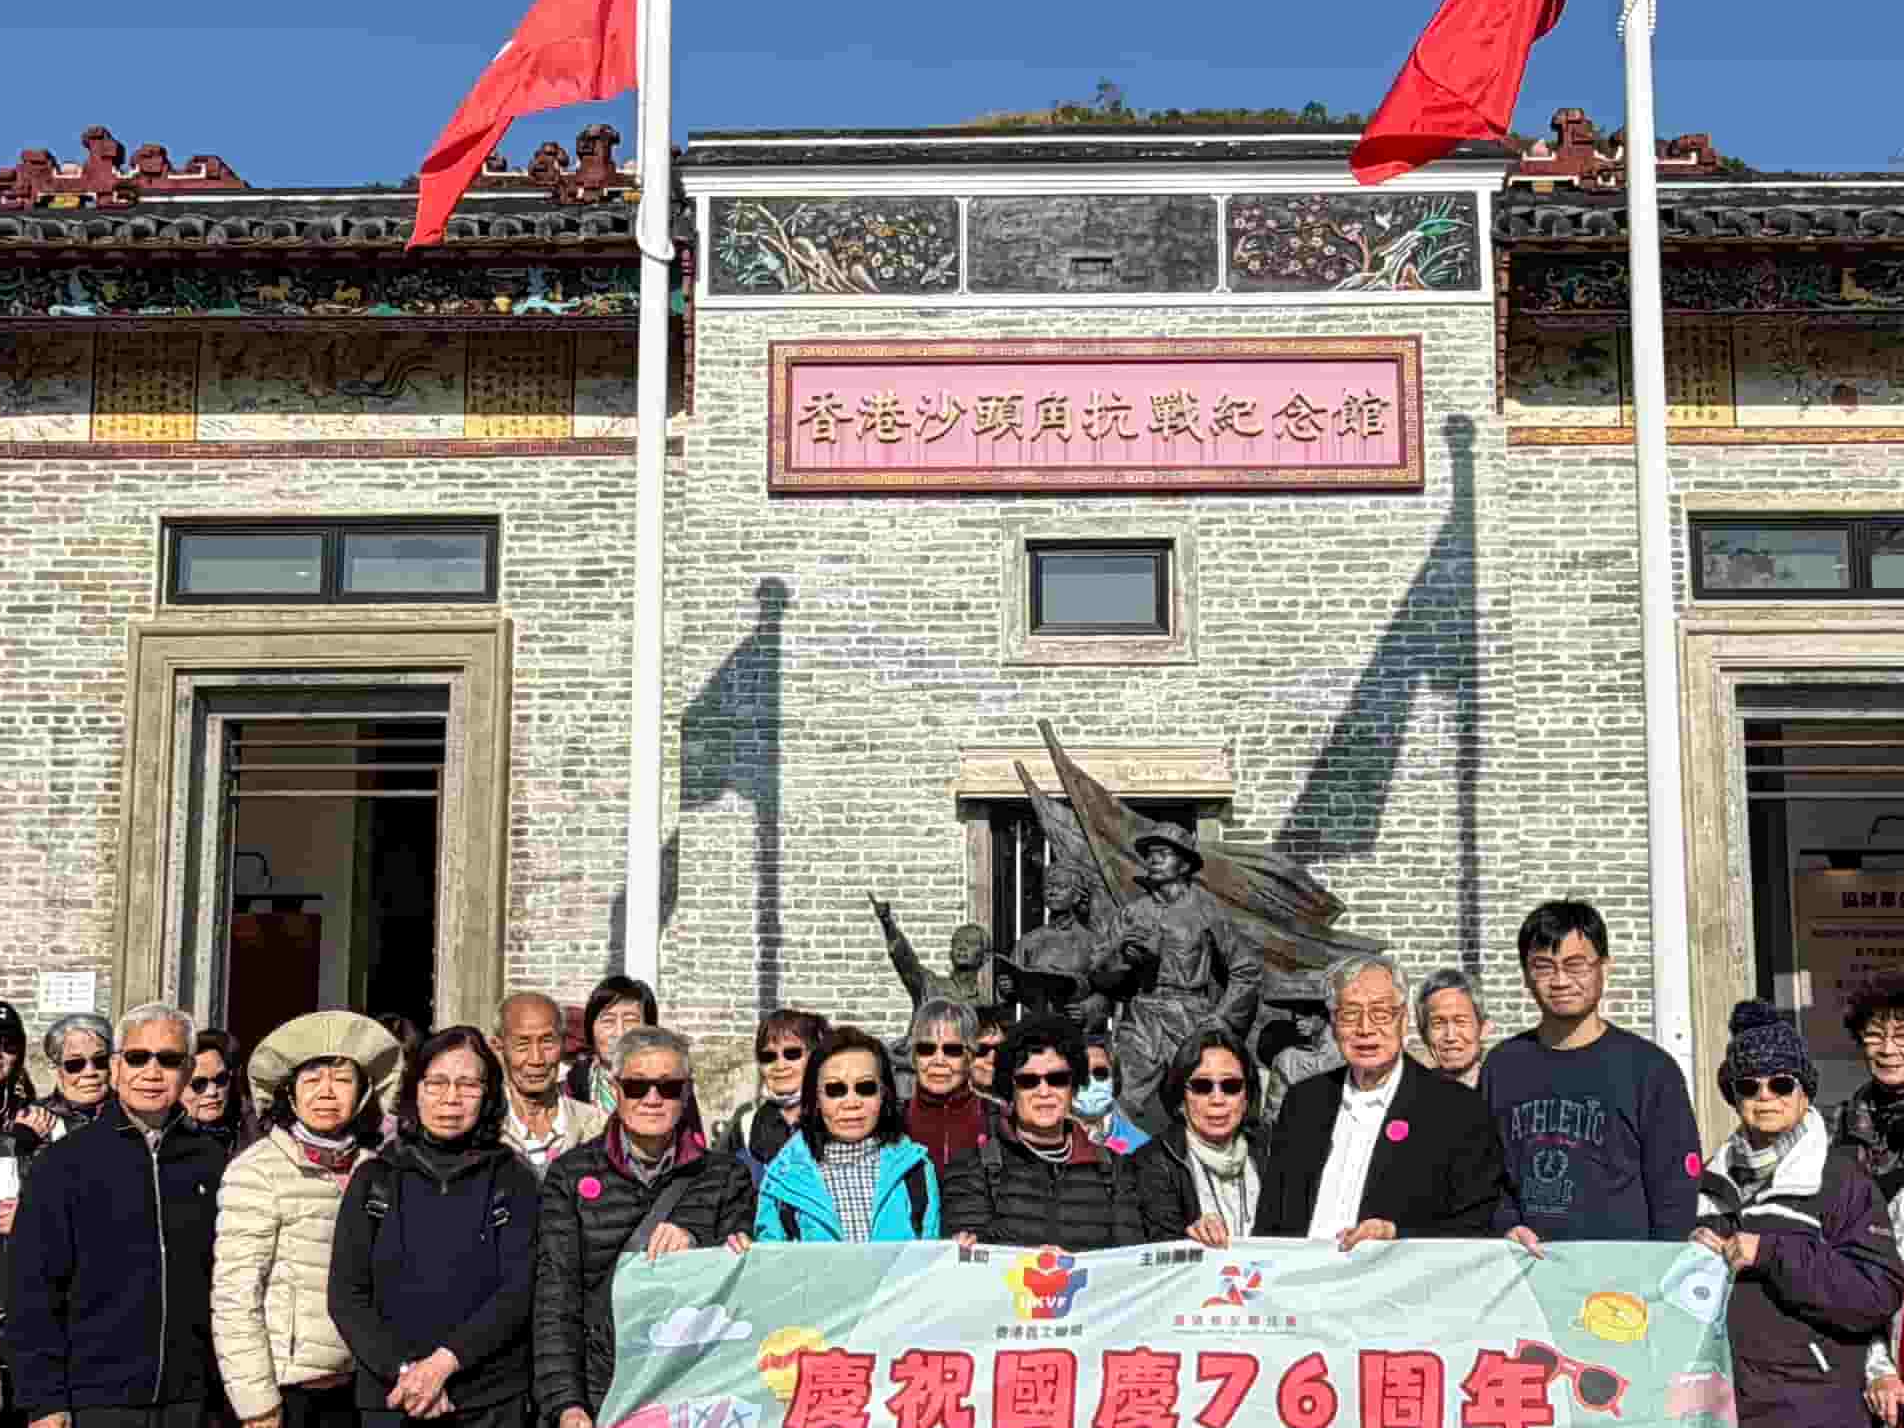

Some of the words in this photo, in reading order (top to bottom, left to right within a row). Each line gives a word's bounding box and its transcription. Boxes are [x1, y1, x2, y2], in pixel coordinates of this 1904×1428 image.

[796, 388, 1392, 445] 香港沙頭角抗戰紀念館
[1511, 1095, 1606, 1148] ATHLETIC
